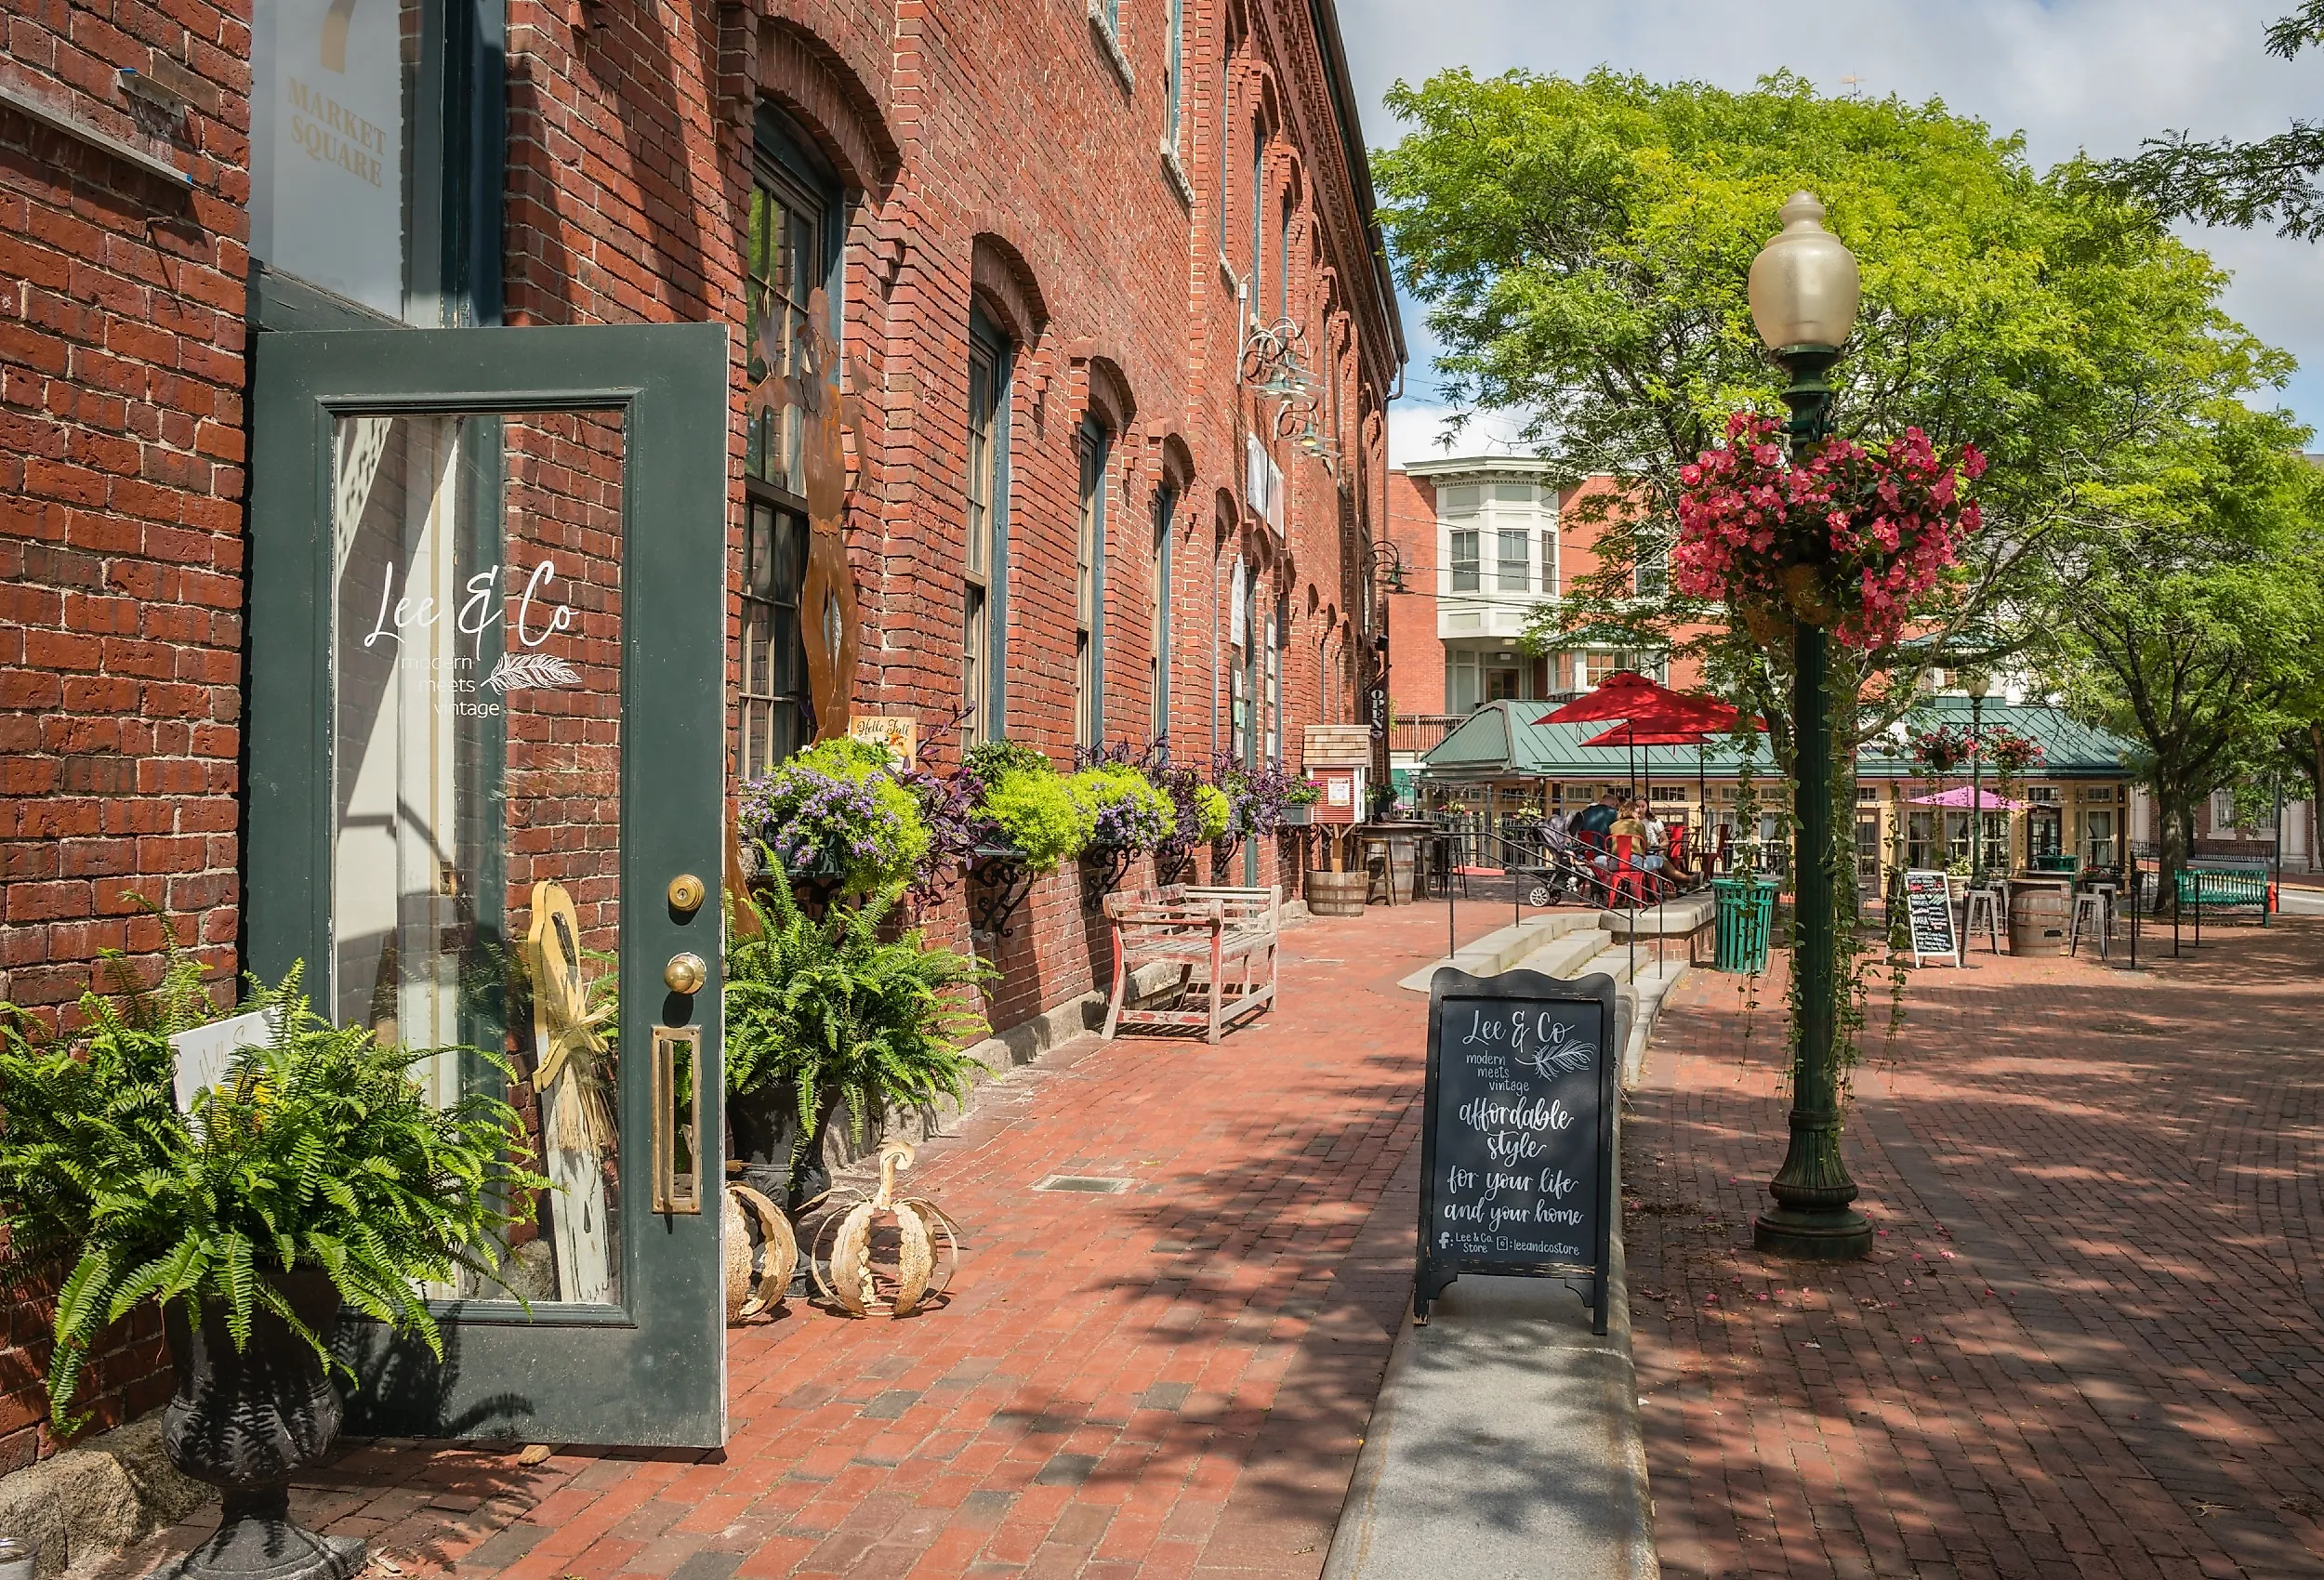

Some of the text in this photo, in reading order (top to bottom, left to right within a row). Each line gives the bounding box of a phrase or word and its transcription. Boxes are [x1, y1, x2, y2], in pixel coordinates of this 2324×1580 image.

[287, 74, 387, 156] MARKET
[290, 114, 383, 188] SQUARE
[363, 560, 580, 661] Lee & Co
[401, 655, 472, 671] modern
[419, 677, 477, 692] meets
[434, 699, 500, 718] vintage
[1370, 689, 1385, 730] OPEN
[856, 718, 910, 737] Hello Fall
[1461, 1009, 1576, 1053] Lee & Co
[1465, 1049, 1506, 1065] modern
[1476, 1066, 1510, 1079] meets
[1488, 1078, 1530, 1098] vintage
[1459, 1096, 1575, 1132] affordable
[1486, 1129, 1548, 1167] style
[1446, 1165, 1579, 1201] for your life
[1444, 1196, 1585, 1232] and your home
[1455, 1231, 1472, 1243] Lee
[1472, 1231, 1480, 1243] &
[1462, 1242, 1488, 1254] Store
